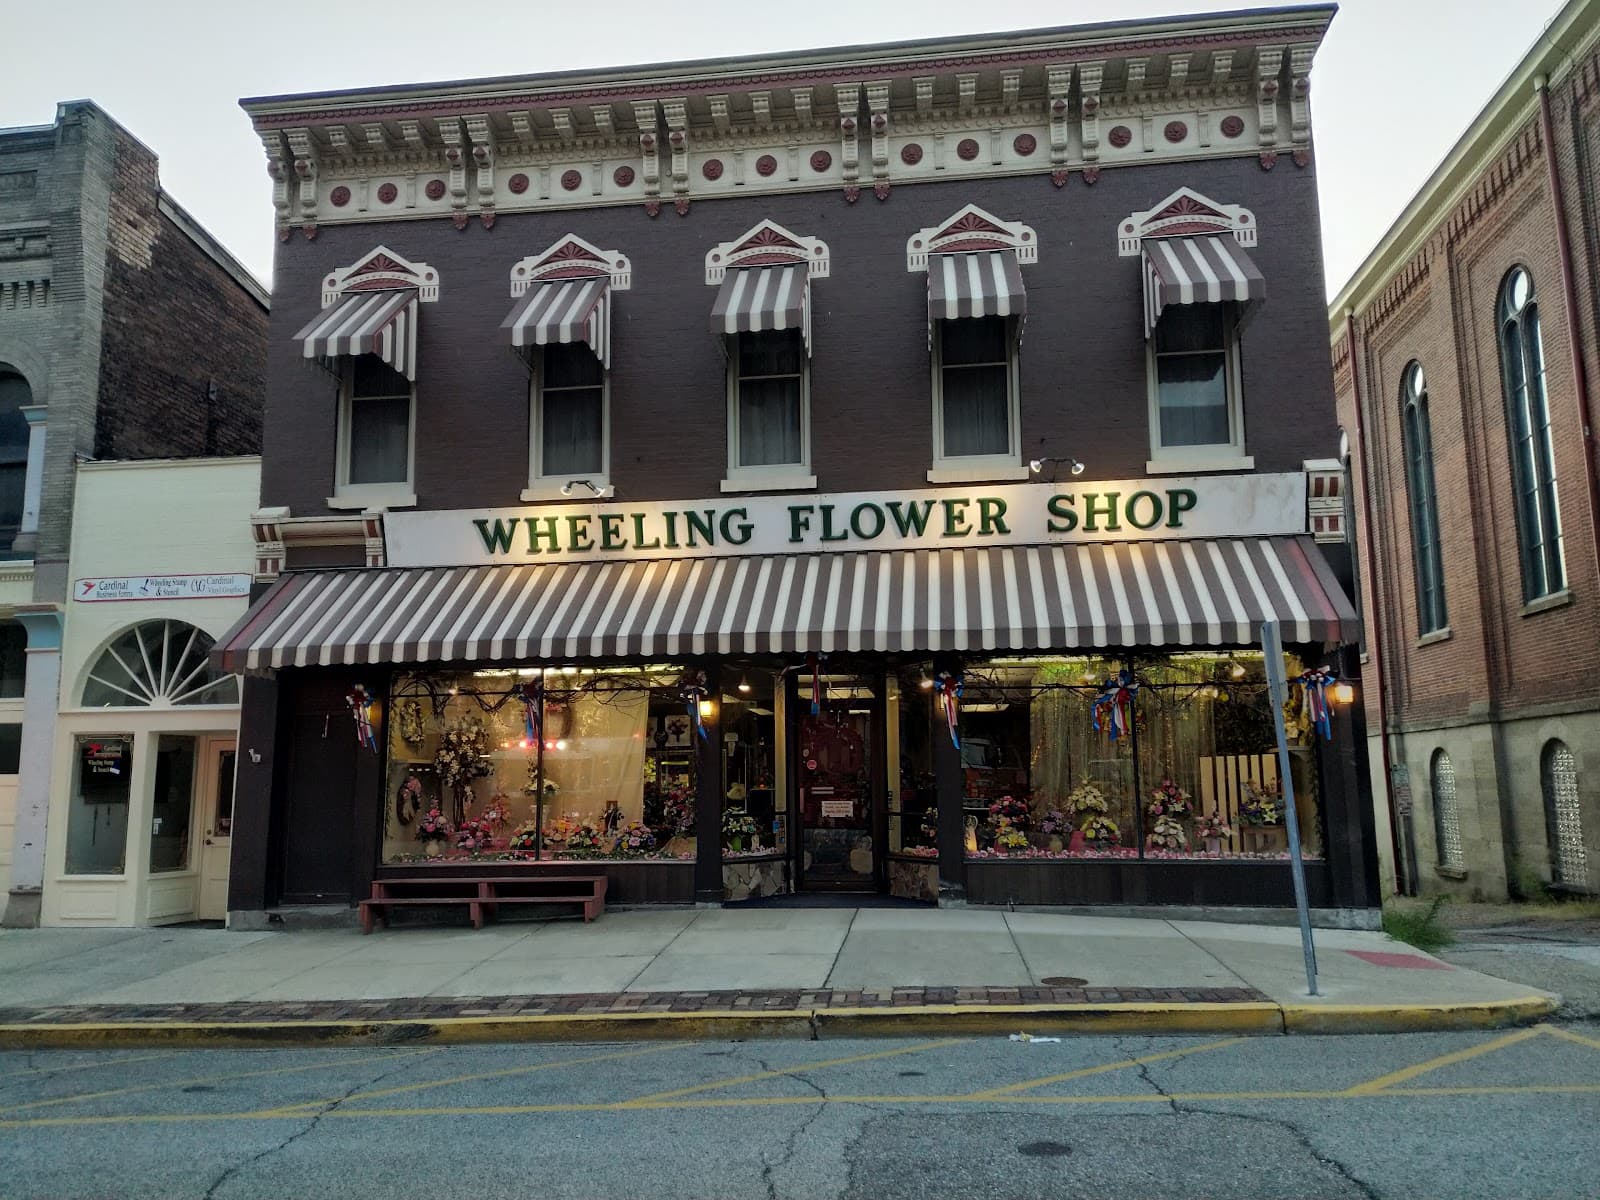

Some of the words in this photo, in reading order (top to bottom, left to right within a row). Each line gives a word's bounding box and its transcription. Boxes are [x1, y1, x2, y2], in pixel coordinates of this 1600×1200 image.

[472, 507, 755, 554] WHEELING
[787, 496, 1011, 543] FLOWER
[1047, 488, 1198, 533] SHOP
[99, 581, 129, 591] Cardinal
